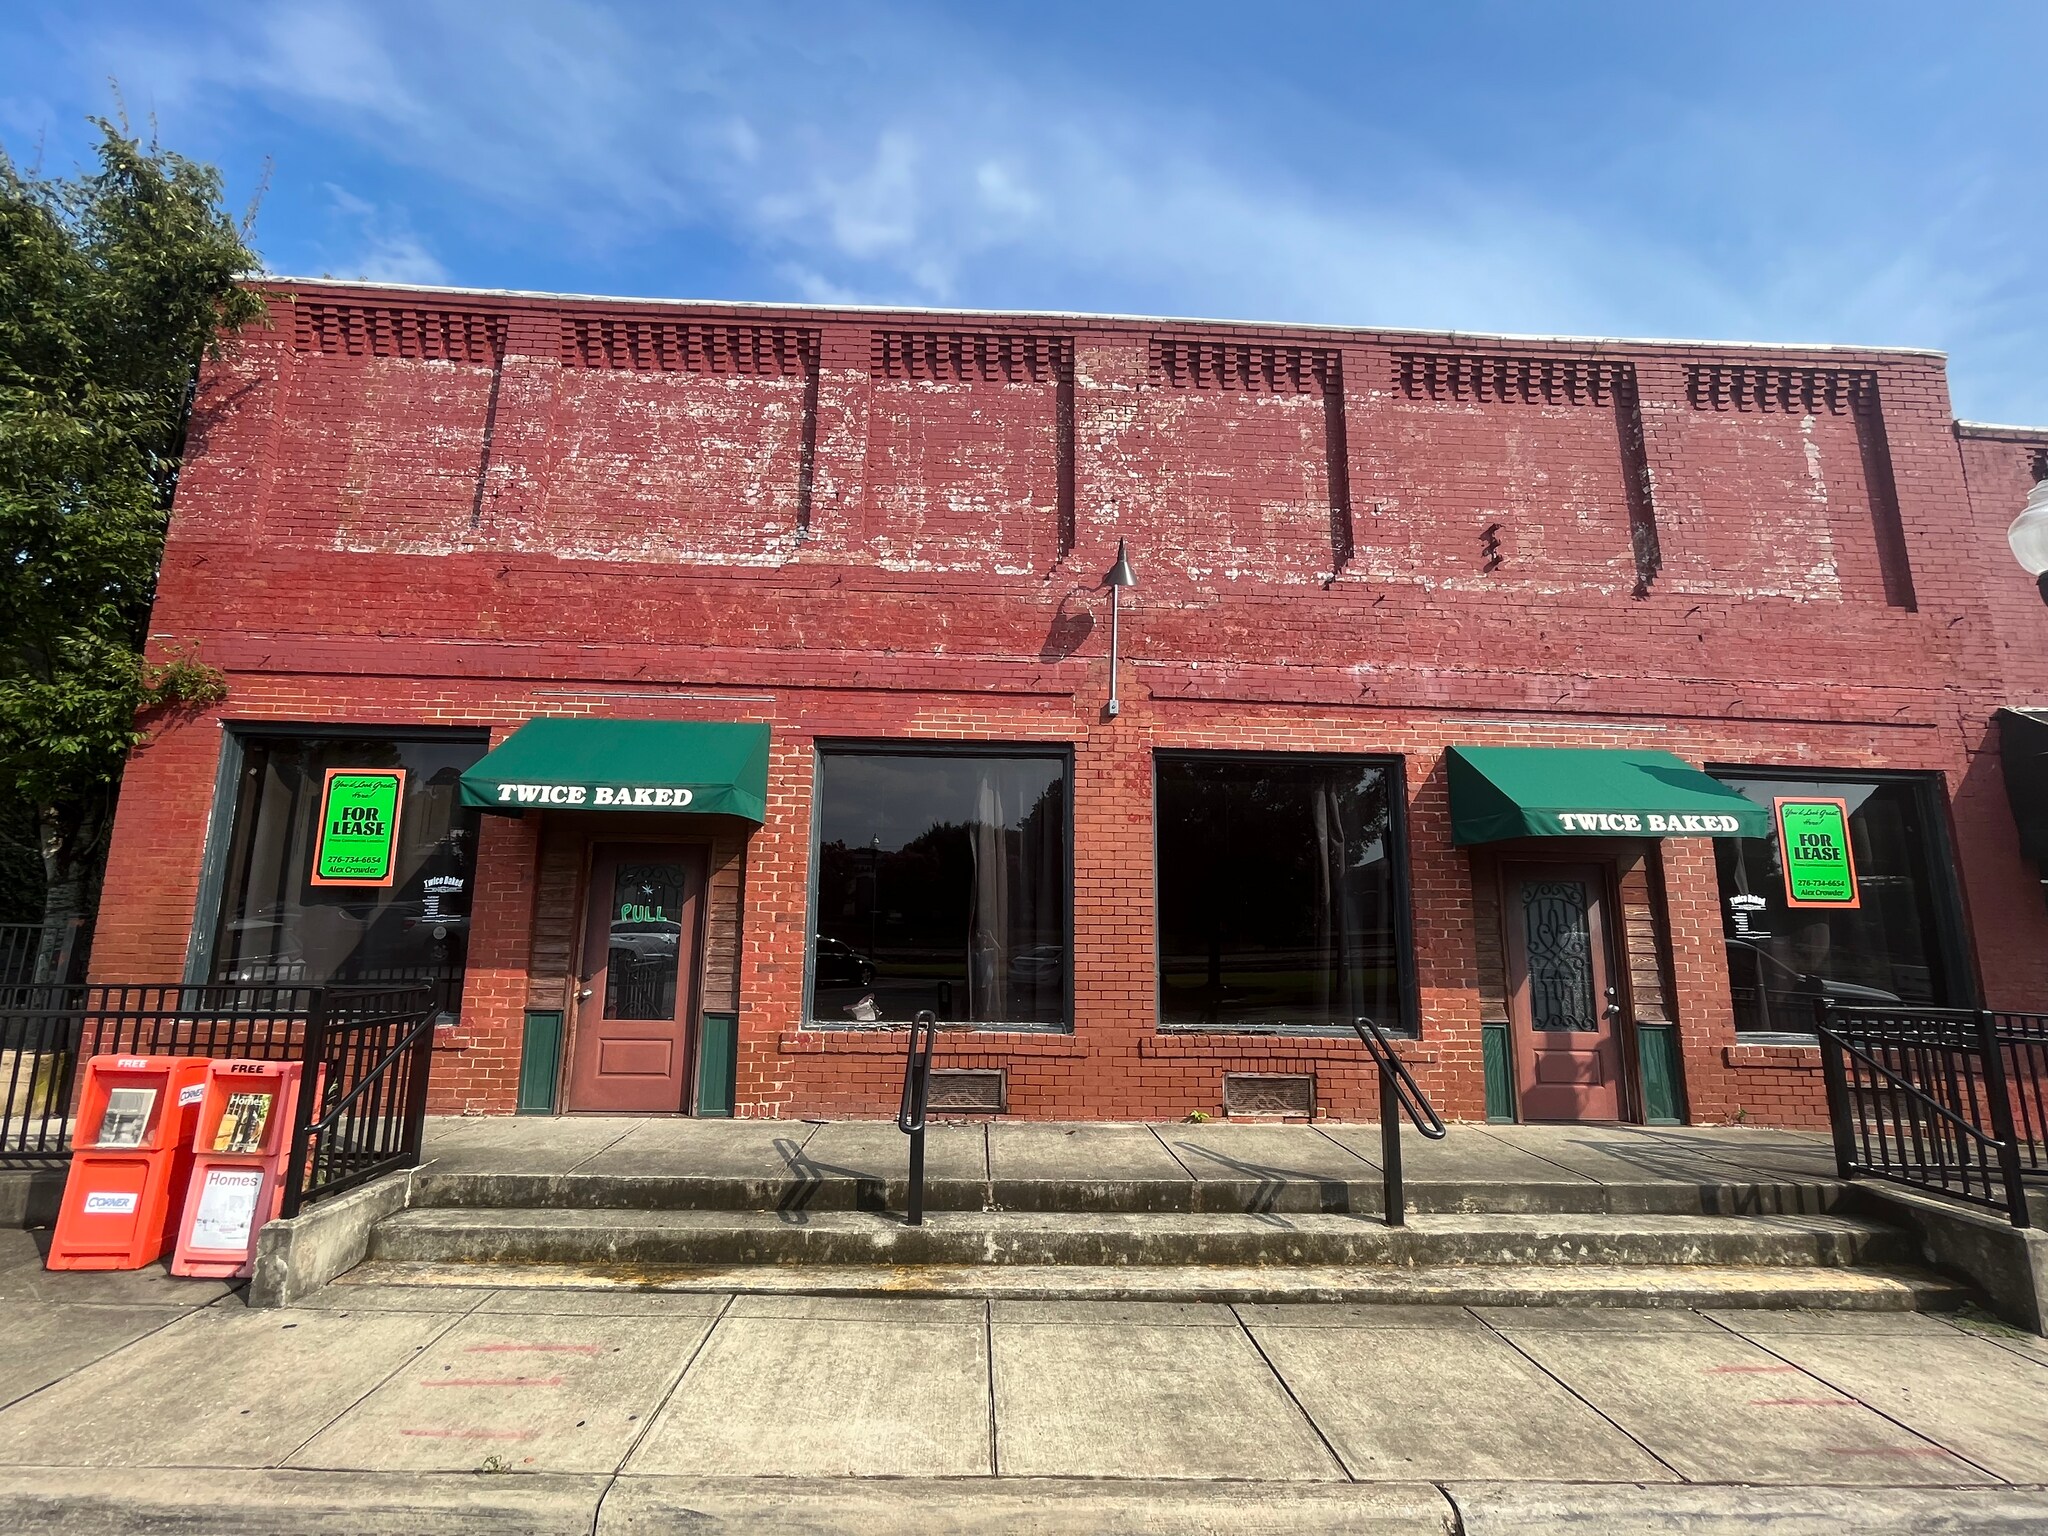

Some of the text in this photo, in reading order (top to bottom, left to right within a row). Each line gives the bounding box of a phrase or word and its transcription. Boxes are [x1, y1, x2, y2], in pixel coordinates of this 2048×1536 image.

[497, 784, 693, 807] TWICE BAKED
[342, 807, 379, 821] FOR
[332, 821, 386, 836] LEASE
[1558, 813, 1740, 832] TWICE BAKED
[1799, 833, 1833, 847] FOR
[327, 856, 381, 864] 276-734-6654
[1794, 847, 1842, 860] LEASE
[345, 866, 378, 874] Crowder
[423, 875, 464, 888] Twice Baked
[1797, 879, 1845, 887] 276-734-6654
[621, 903, 668, 923] PULL
[117, 1059, 148, 1068] FREE
[231, 1064, 265, 1074] FREE
[230, 1096, 264, 1106] Homes
[209, 1172, 258, 1187] Homes
[88, 1196, 130, 1208] CORNER
